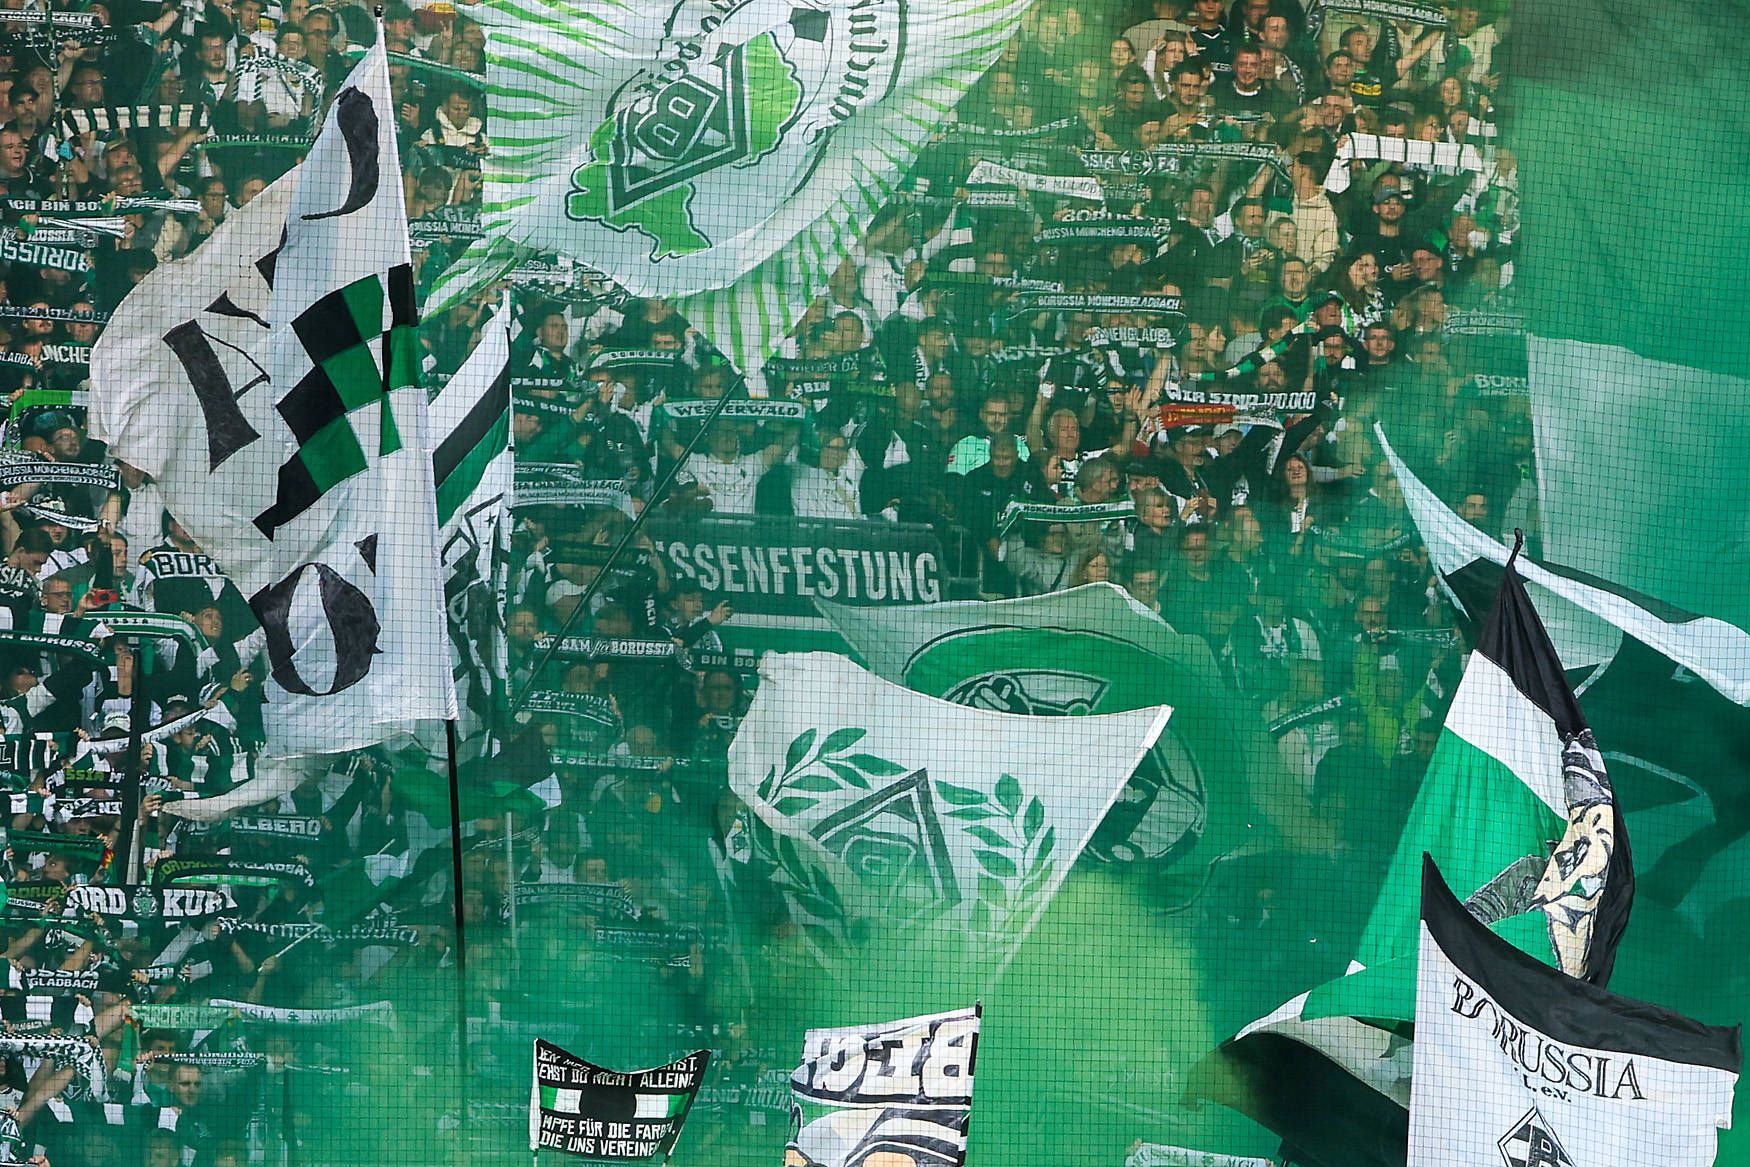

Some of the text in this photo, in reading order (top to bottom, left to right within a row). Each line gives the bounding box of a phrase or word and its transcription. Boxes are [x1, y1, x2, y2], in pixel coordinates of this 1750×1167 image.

[41, 200, 70, 212] BIN
[656, 539, 941, 603] SSENFESTUNG
[611, 641, 675, 657] BORUSSIA
[1453, 976, 1647, 1102] BORUSSIA
[537, 1062, 568, 1083] EHST
[579, 1117, 603, 1139] FÜR
[608, 1121, 632, 1140] DIE
[539, 1130, 562, 1149] DIE
[567, 1136, 595, 1155] UNS
